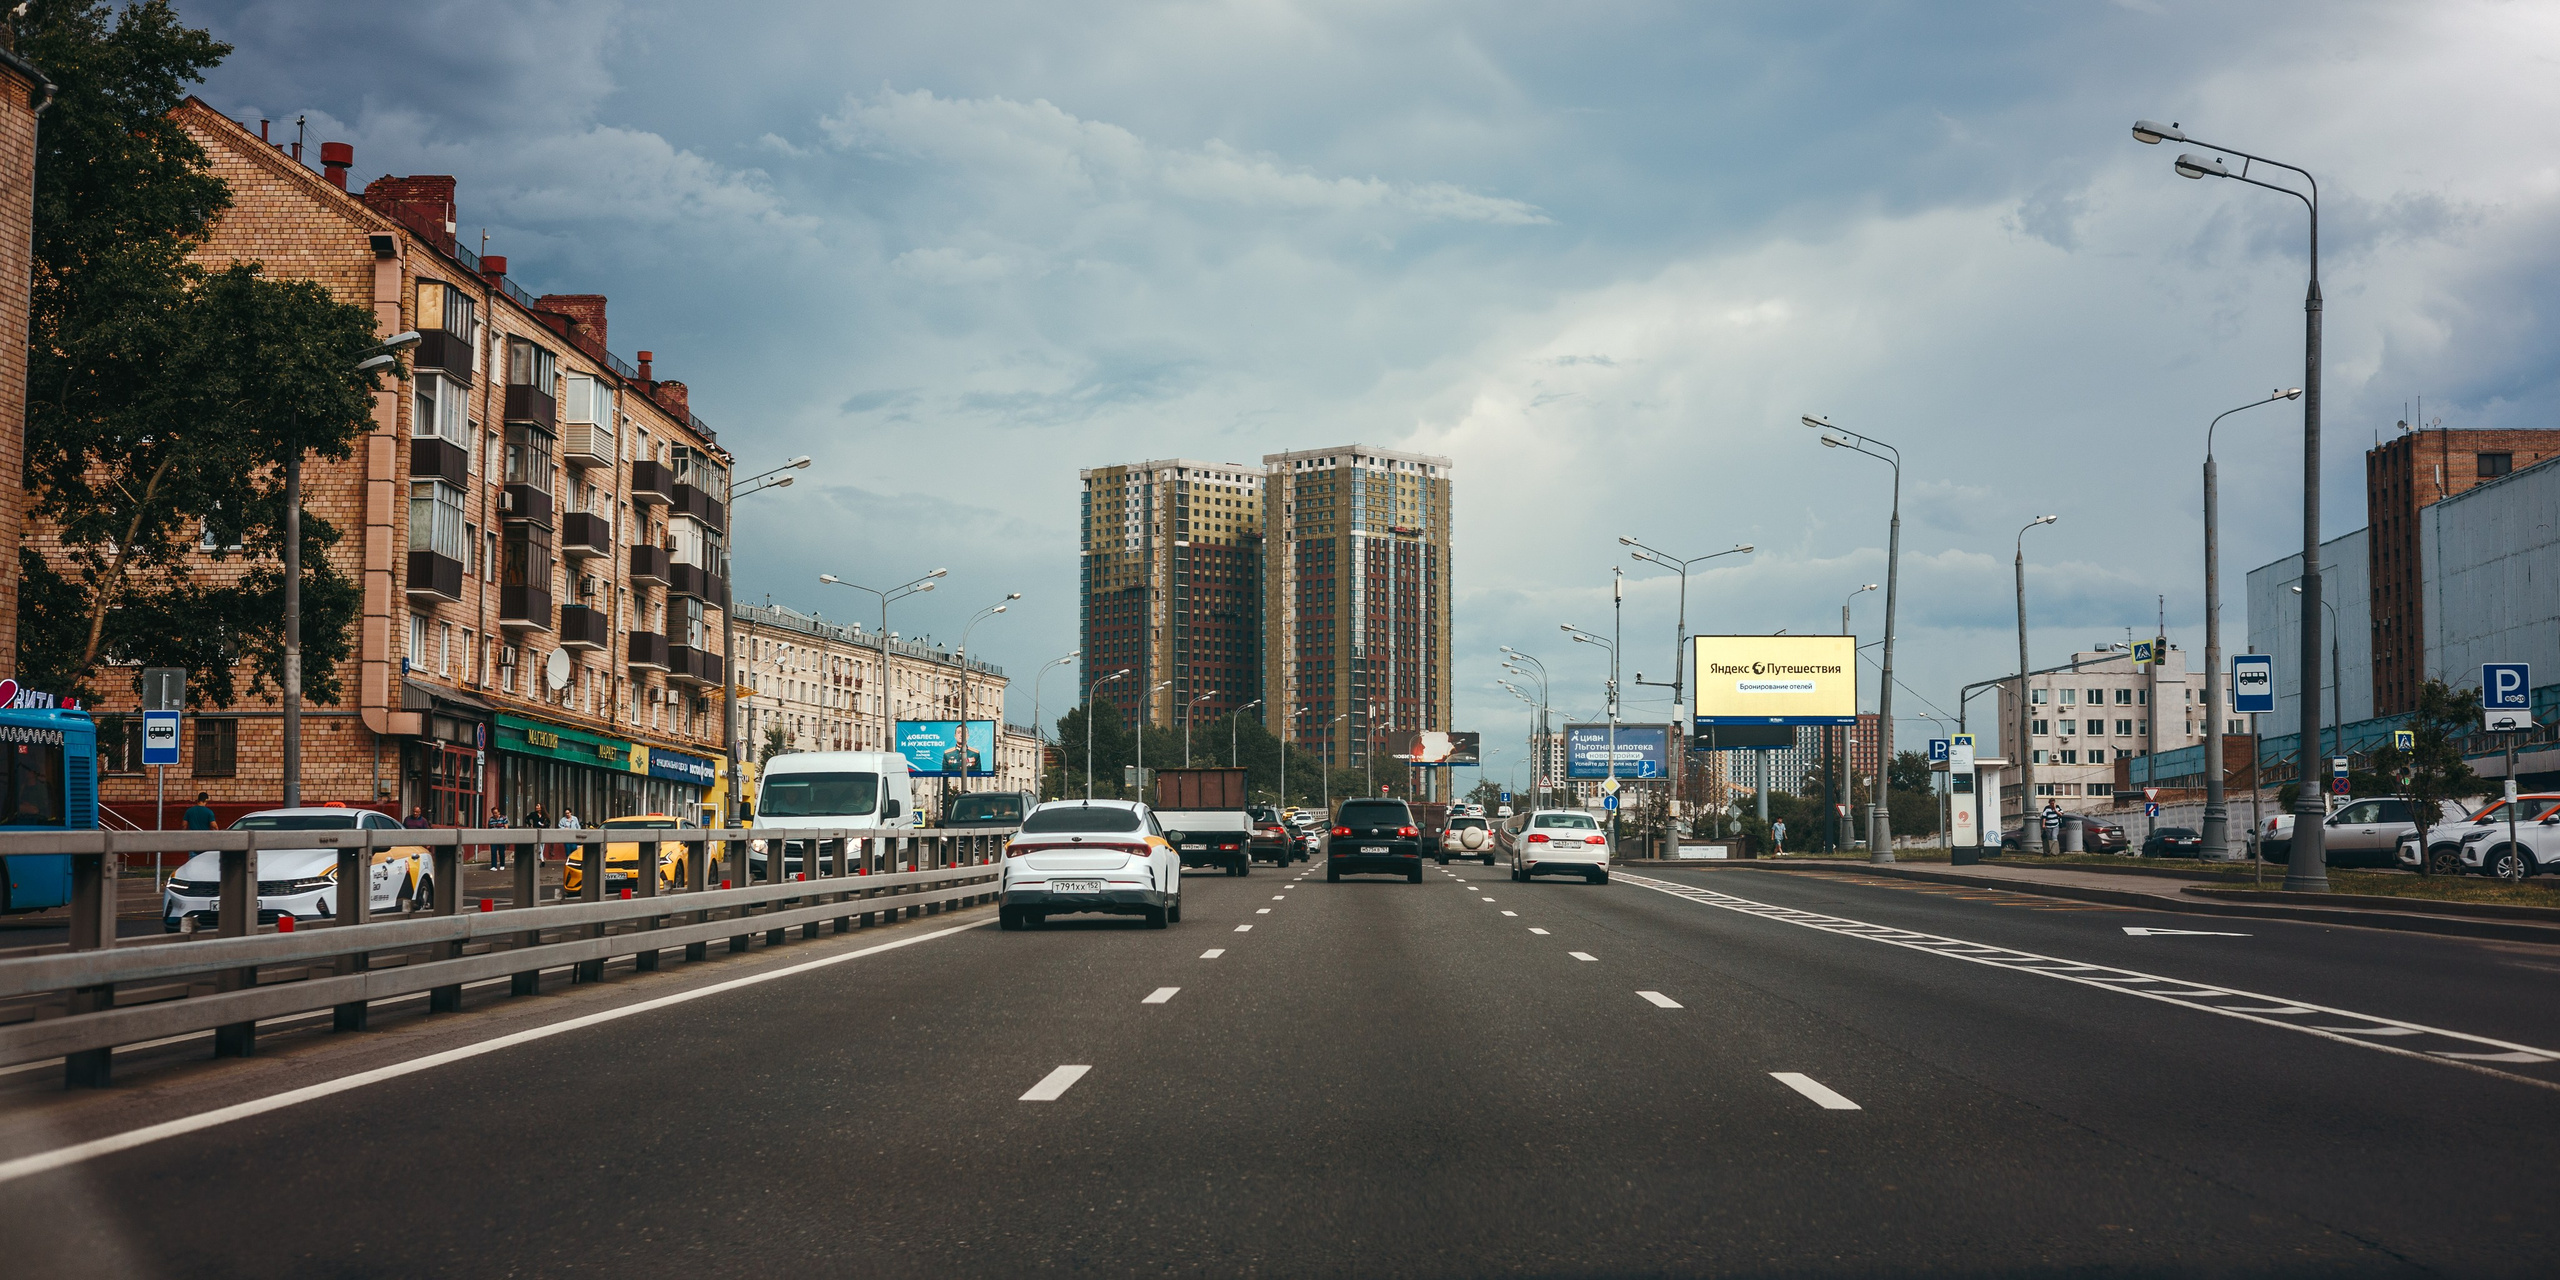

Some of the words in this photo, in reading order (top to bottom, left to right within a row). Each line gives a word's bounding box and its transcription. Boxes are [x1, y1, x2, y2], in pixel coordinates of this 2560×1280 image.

[1710, 663, 1750, 675] Яндекс
[1767, 663, 1841, 675] Путешествия
[2495, 669, 2521, 704] P
[528, 729, 559, 749] МАГНОЛИЯ
[1574, 743, 1615, 751] Льготна
[1617, 743, 1654, 751] ипотека
[1580, 735, 1604, 743] циан
[598, 744, 617, 761] МАРКЕТ
[1935, 741, 1947, 758] P
